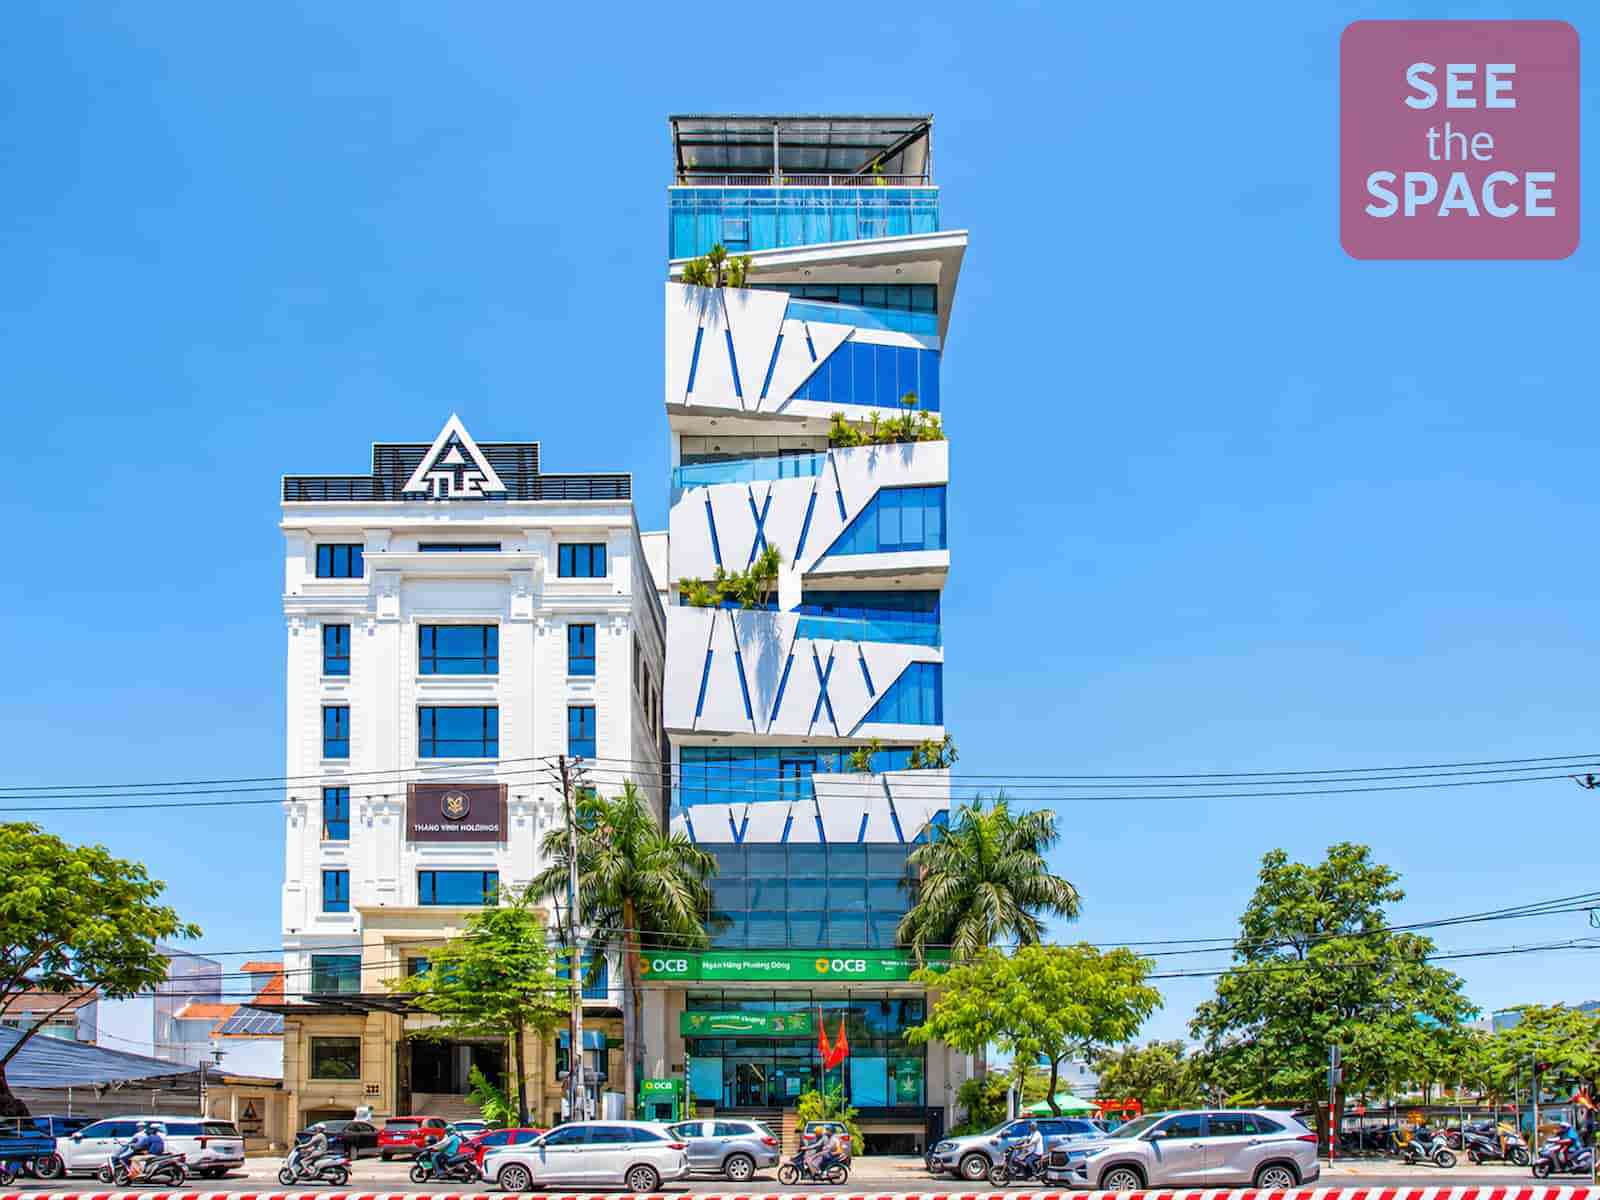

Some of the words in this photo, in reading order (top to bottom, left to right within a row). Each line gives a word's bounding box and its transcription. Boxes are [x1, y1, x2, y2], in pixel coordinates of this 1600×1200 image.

[652, 959, 689, 972] OCB
[831, 959, 867, 972] OCB
[654, 1081, 673, 1090] OCB
